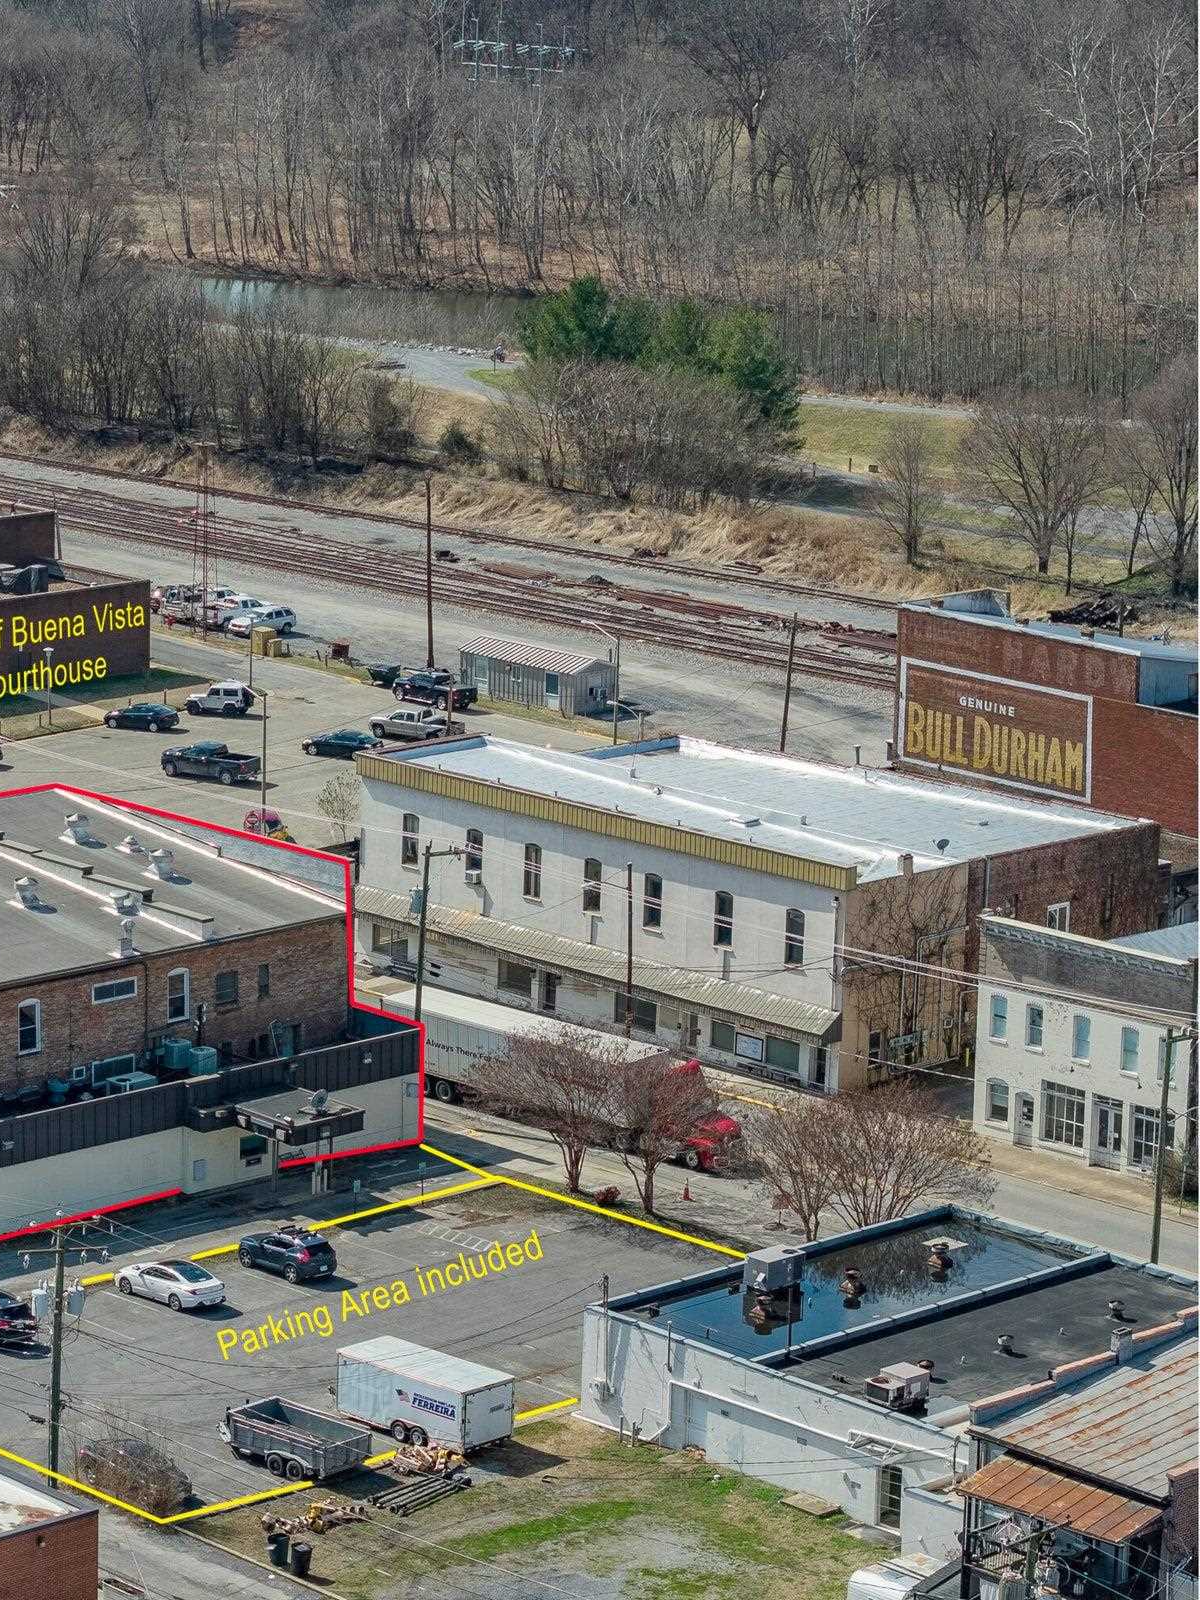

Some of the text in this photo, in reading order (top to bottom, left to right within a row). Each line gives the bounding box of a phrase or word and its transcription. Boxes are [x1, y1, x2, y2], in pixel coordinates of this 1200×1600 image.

[959, 696, 1015, 718] GENUINE
[907, 701, 1084, 791] BULL DURHAM
[426, 1038, 454, 1053] Always
[455, 1046, 478, 1058] There
[412, 1396, 456, 1418] FERREIRA
